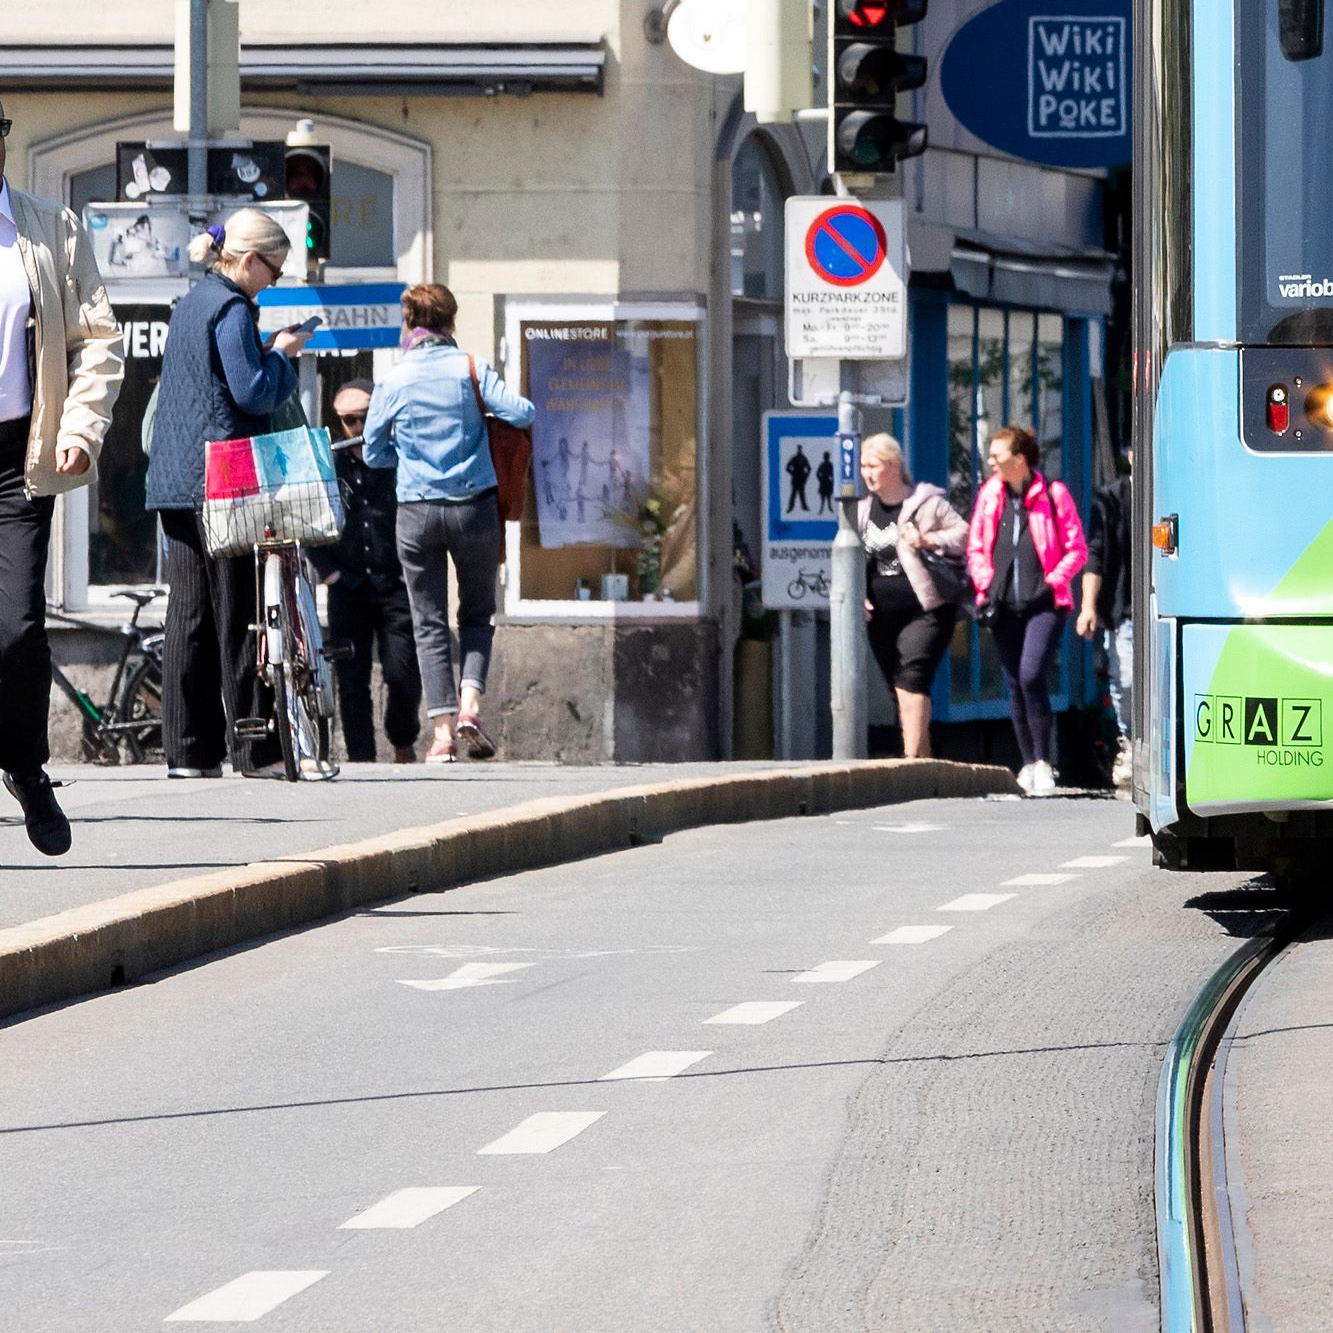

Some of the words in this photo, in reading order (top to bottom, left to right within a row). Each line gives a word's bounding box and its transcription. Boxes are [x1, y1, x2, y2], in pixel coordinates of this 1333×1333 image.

[792, 292, 899, 303] KURZPARKZONE
[1196, 700, 1313, 741] GRAZ
[1257, 749, 1324, 767] HOLDING
